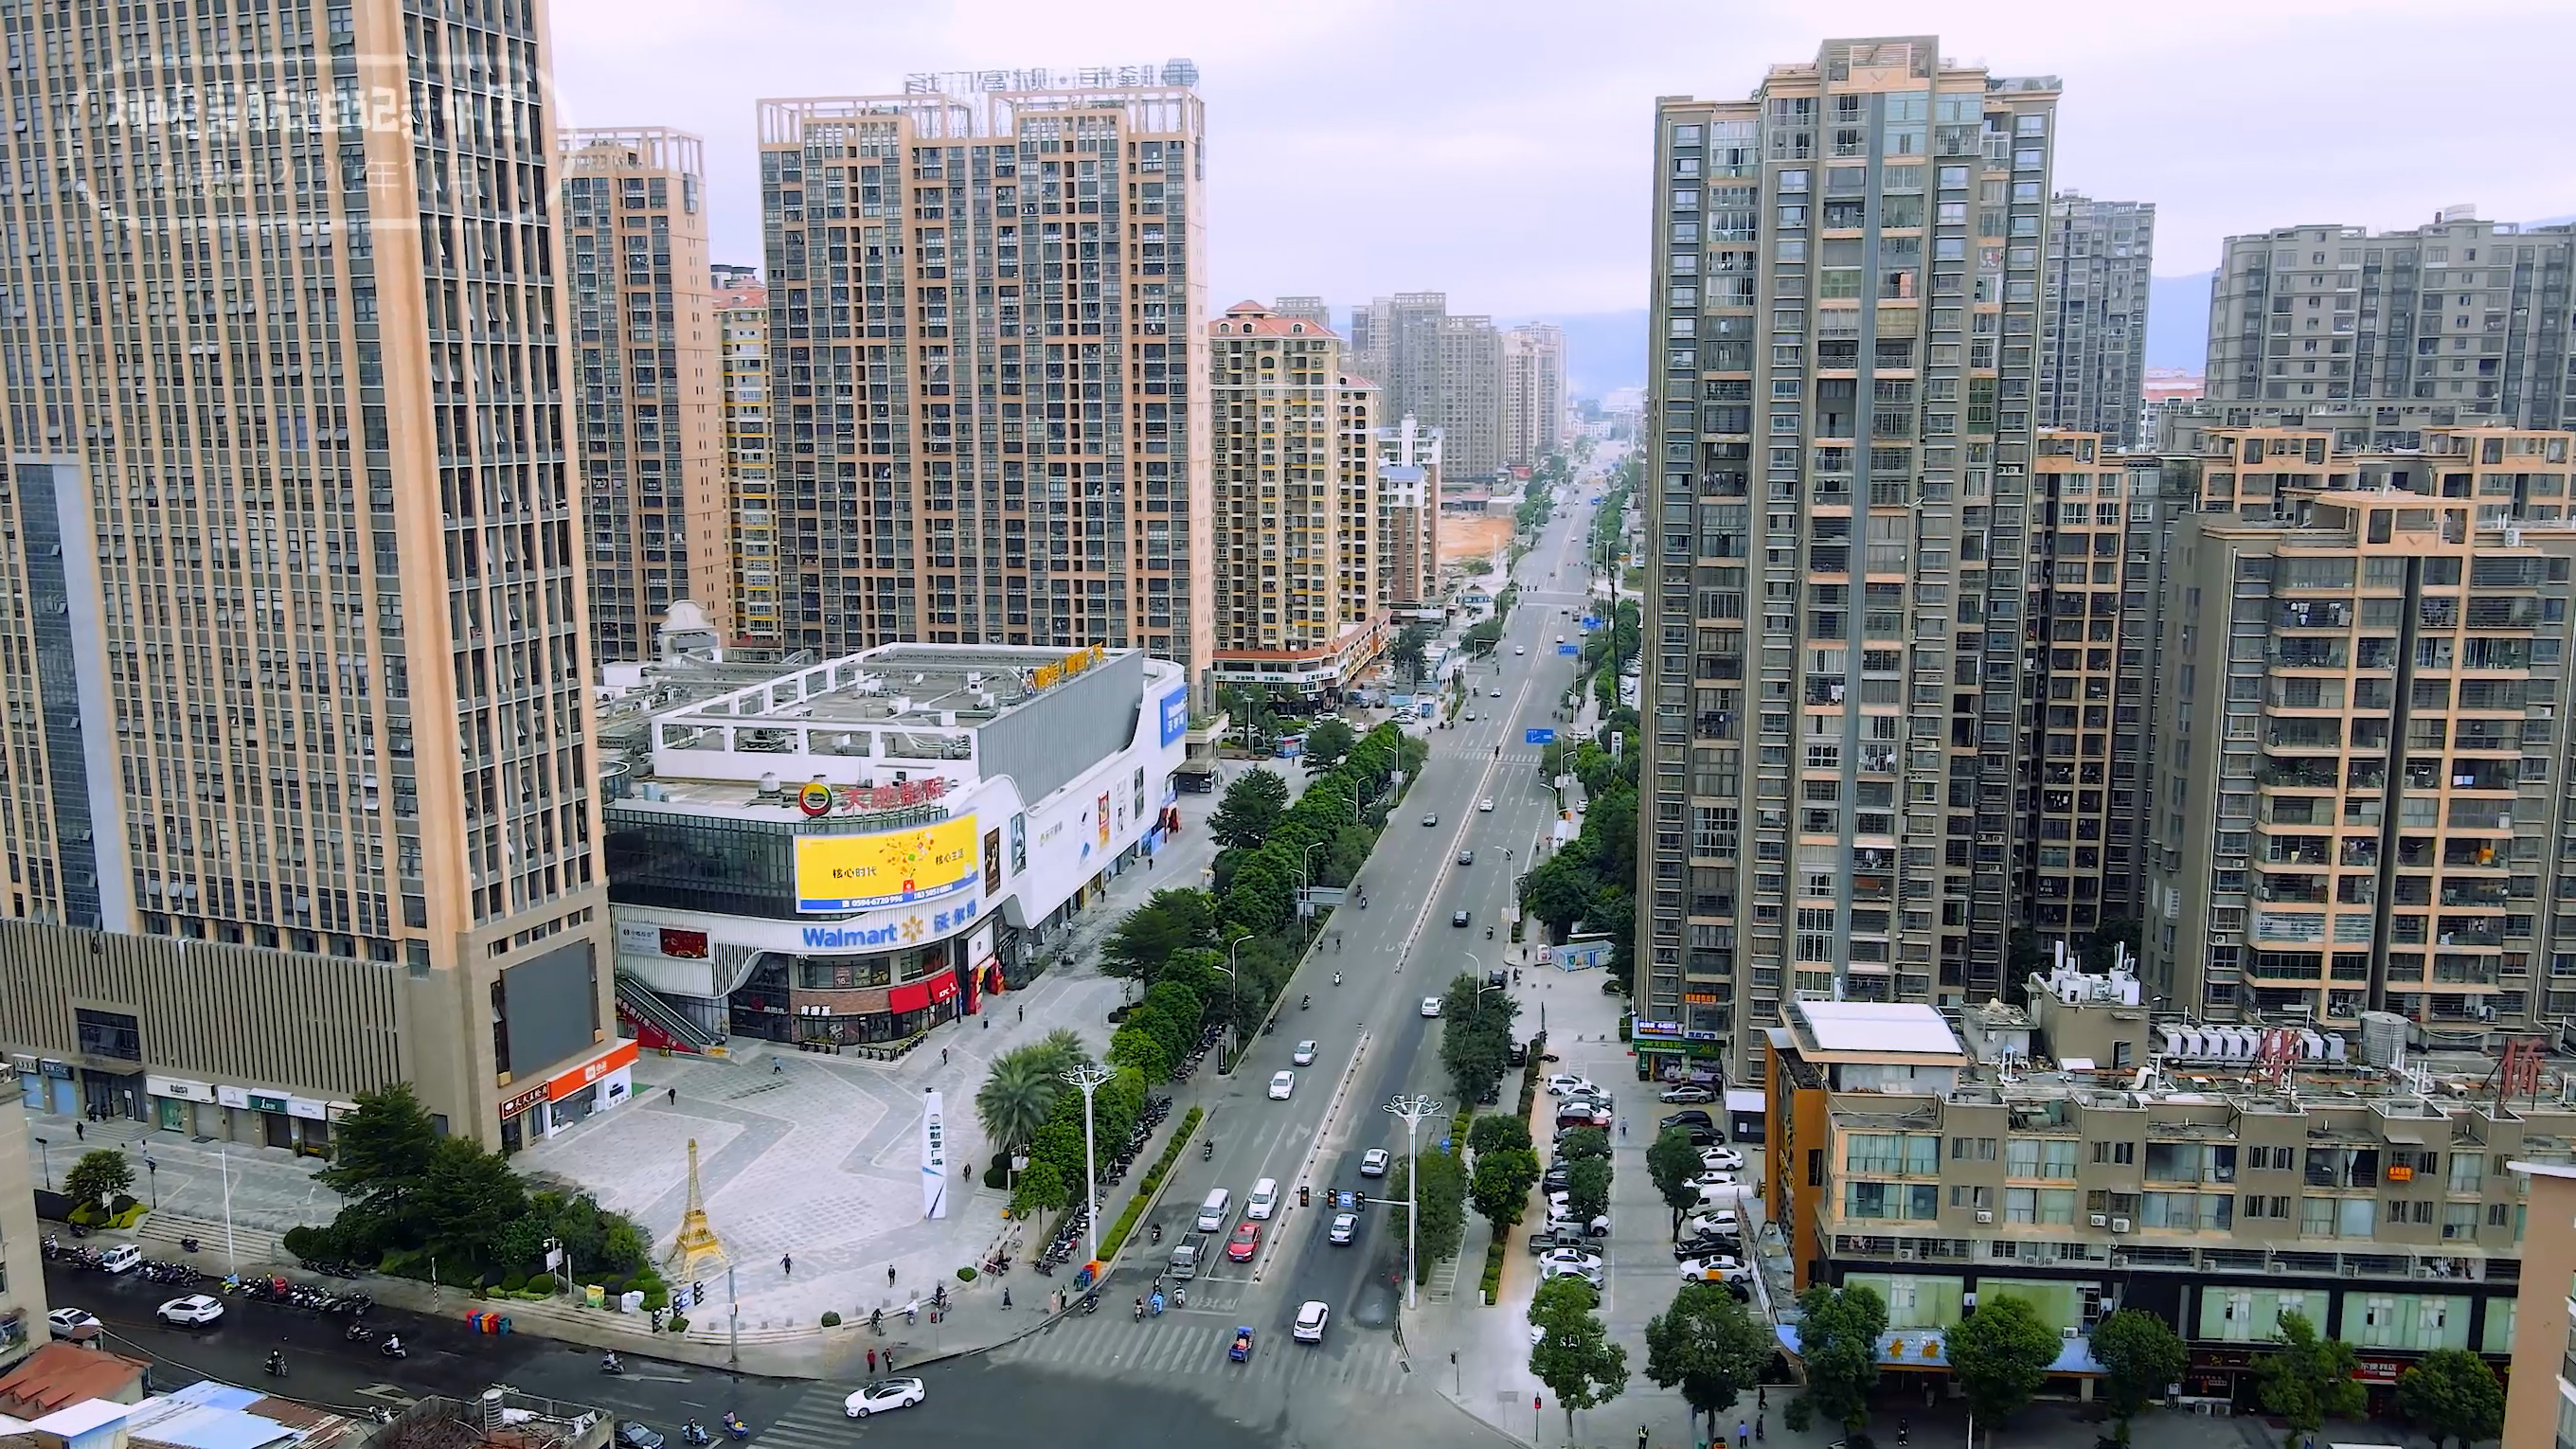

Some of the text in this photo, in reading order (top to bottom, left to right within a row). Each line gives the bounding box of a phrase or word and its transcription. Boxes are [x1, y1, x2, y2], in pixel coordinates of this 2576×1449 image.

[832, 866, 877, 879] 核心时代
[803, 923, 897, 947] Walmart
